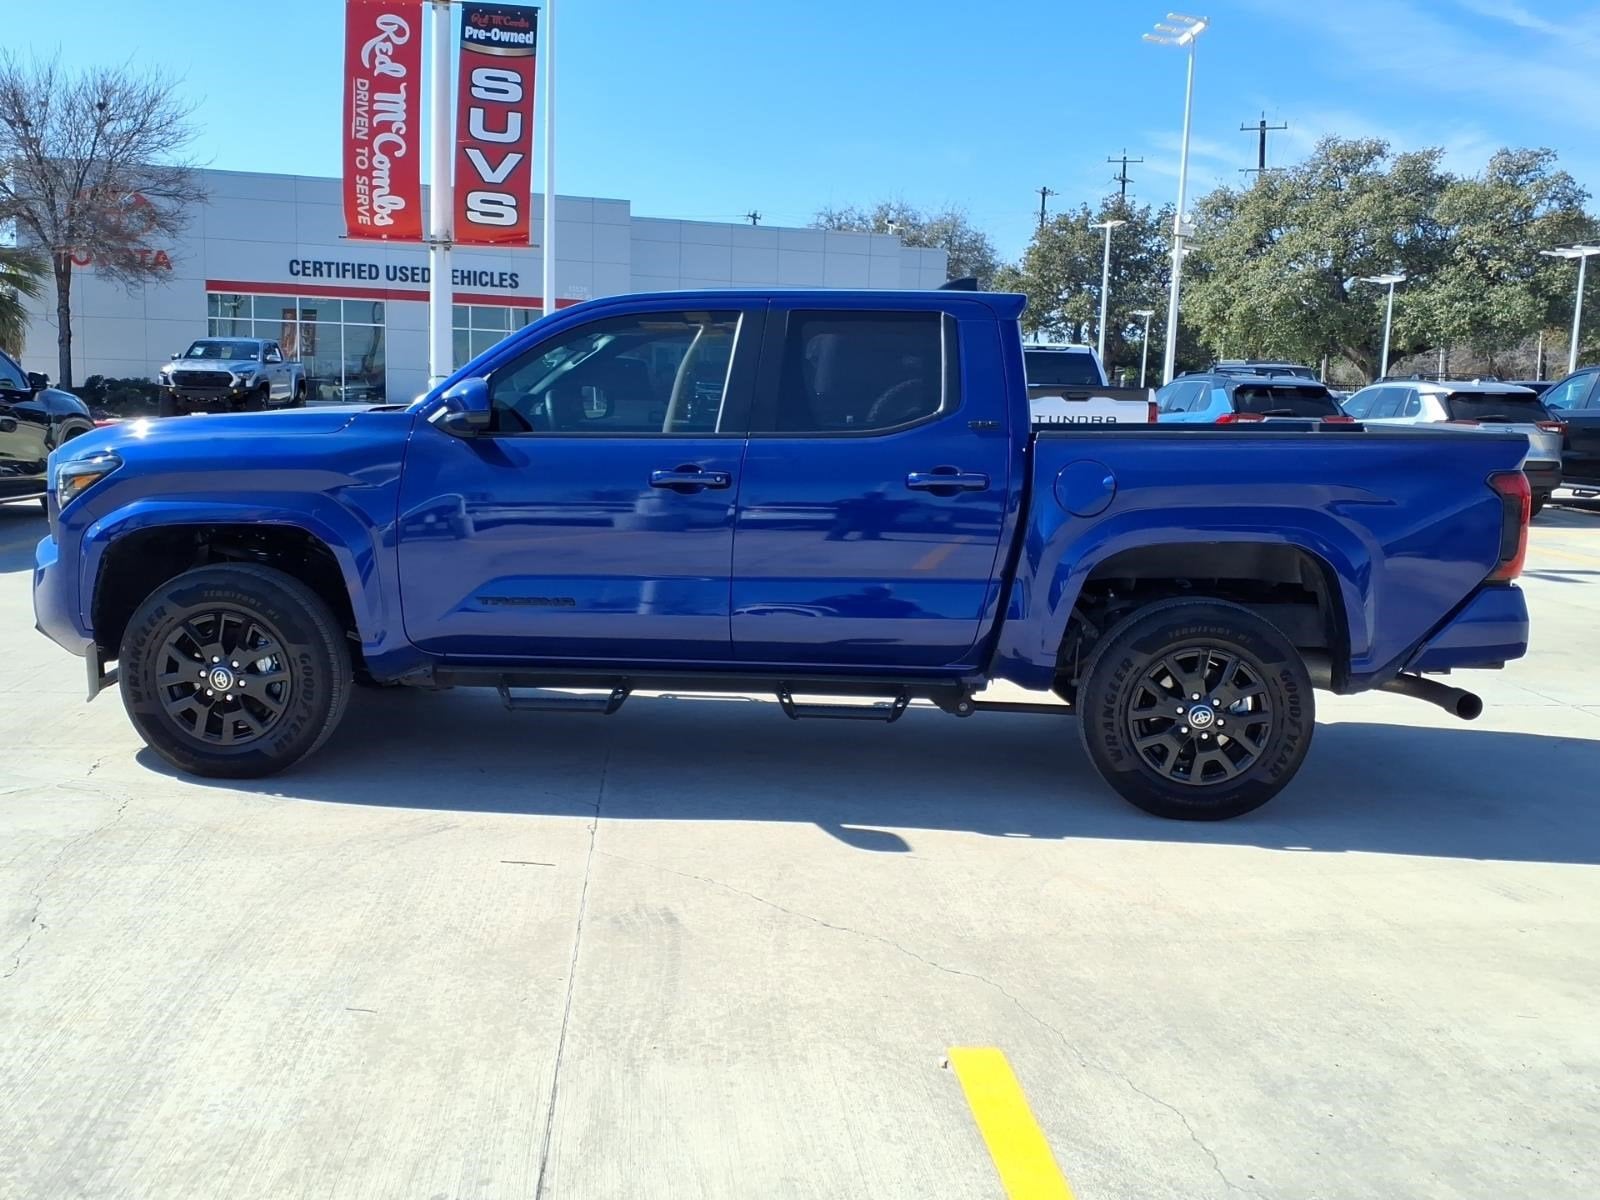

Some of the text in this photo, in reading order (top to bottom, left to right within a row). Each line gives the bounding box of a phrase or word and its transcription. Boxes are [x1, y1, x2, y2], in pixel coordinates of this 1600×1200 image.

[465, 26, 534, 44] Pre-Owned
[471, 13, 489, 27] Red
[361, 14, 410, 77] Red
[355, 78, 370, 225] DRIVEN TO SERVE
[289, 259, 519, 289] CERTIFIED USED EHICLES
[1034, 415, 1118, 423] TUNDRA
[128, 606, 168, 703] WRANGLER
[1102, 658, 1136, 763] WRANGLER
